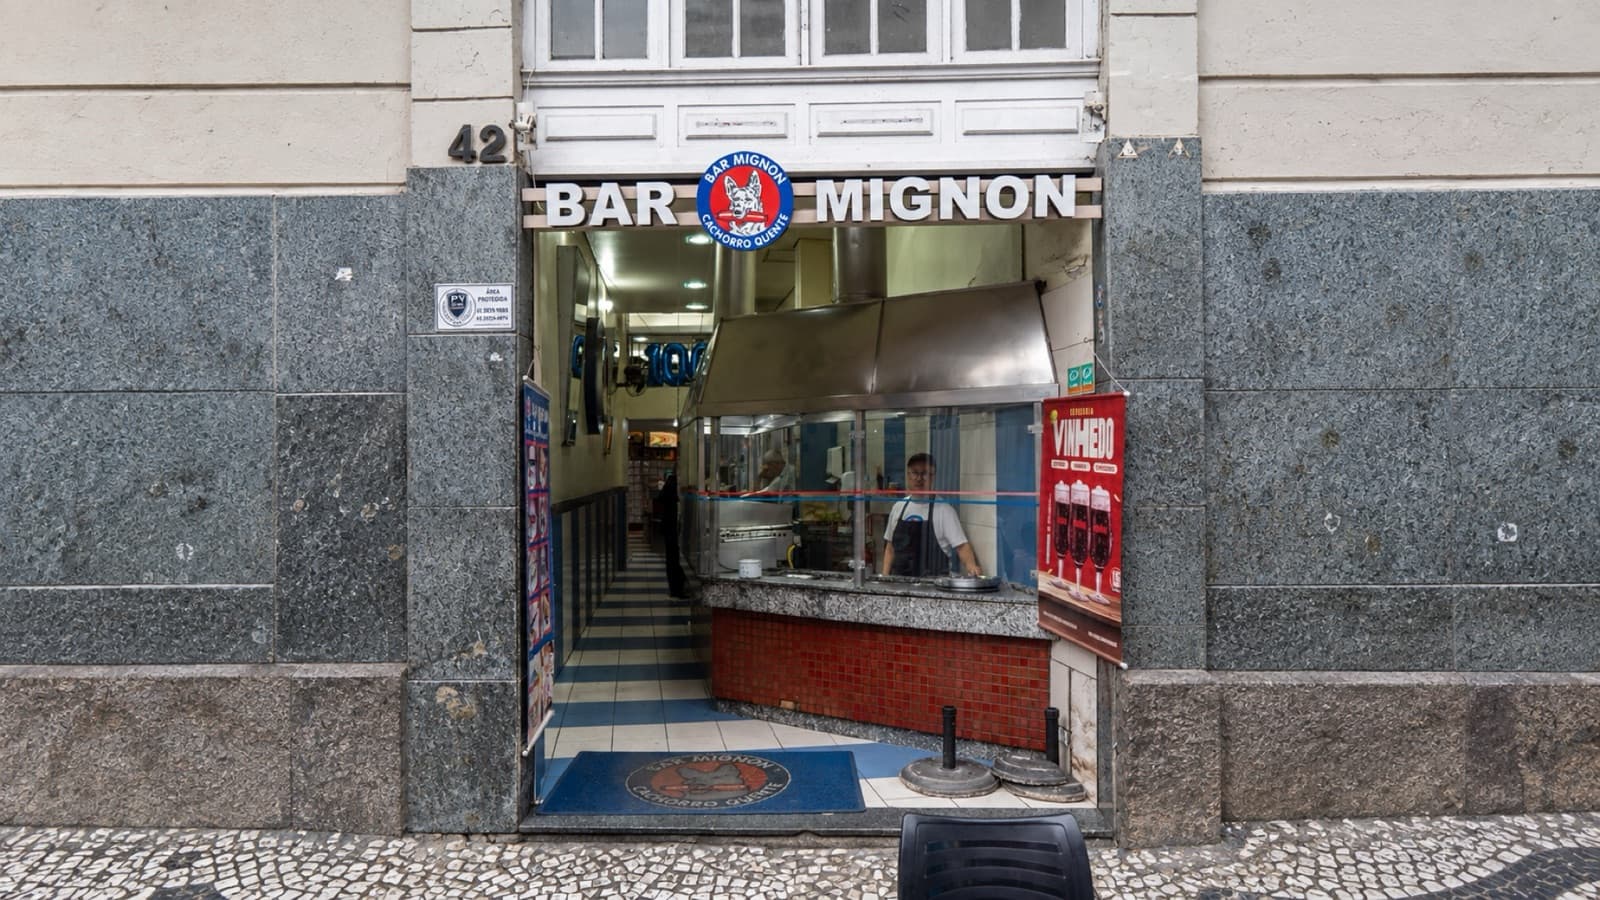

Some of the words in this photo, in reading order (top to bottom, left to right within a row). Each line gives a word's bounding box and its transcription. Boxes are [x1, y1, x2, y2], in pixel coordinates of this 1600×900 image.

[448, 124, 507, 163] 42
[705, 159, 730, 184] BAR
[733, 153, 787, 185] MIGNON
[545, 182, 679, 227] BAR
[816, 174, 1077, 223] MIGNON
[702, 214, 752, 249] CACHORRO
[754, 213, 789, 247] QUENTE
[1053, 417, 1115, 460] VINHEDO
[633, 785, 719, 808] CACHORRO
[725, 782, 784, 806] QUENTE
